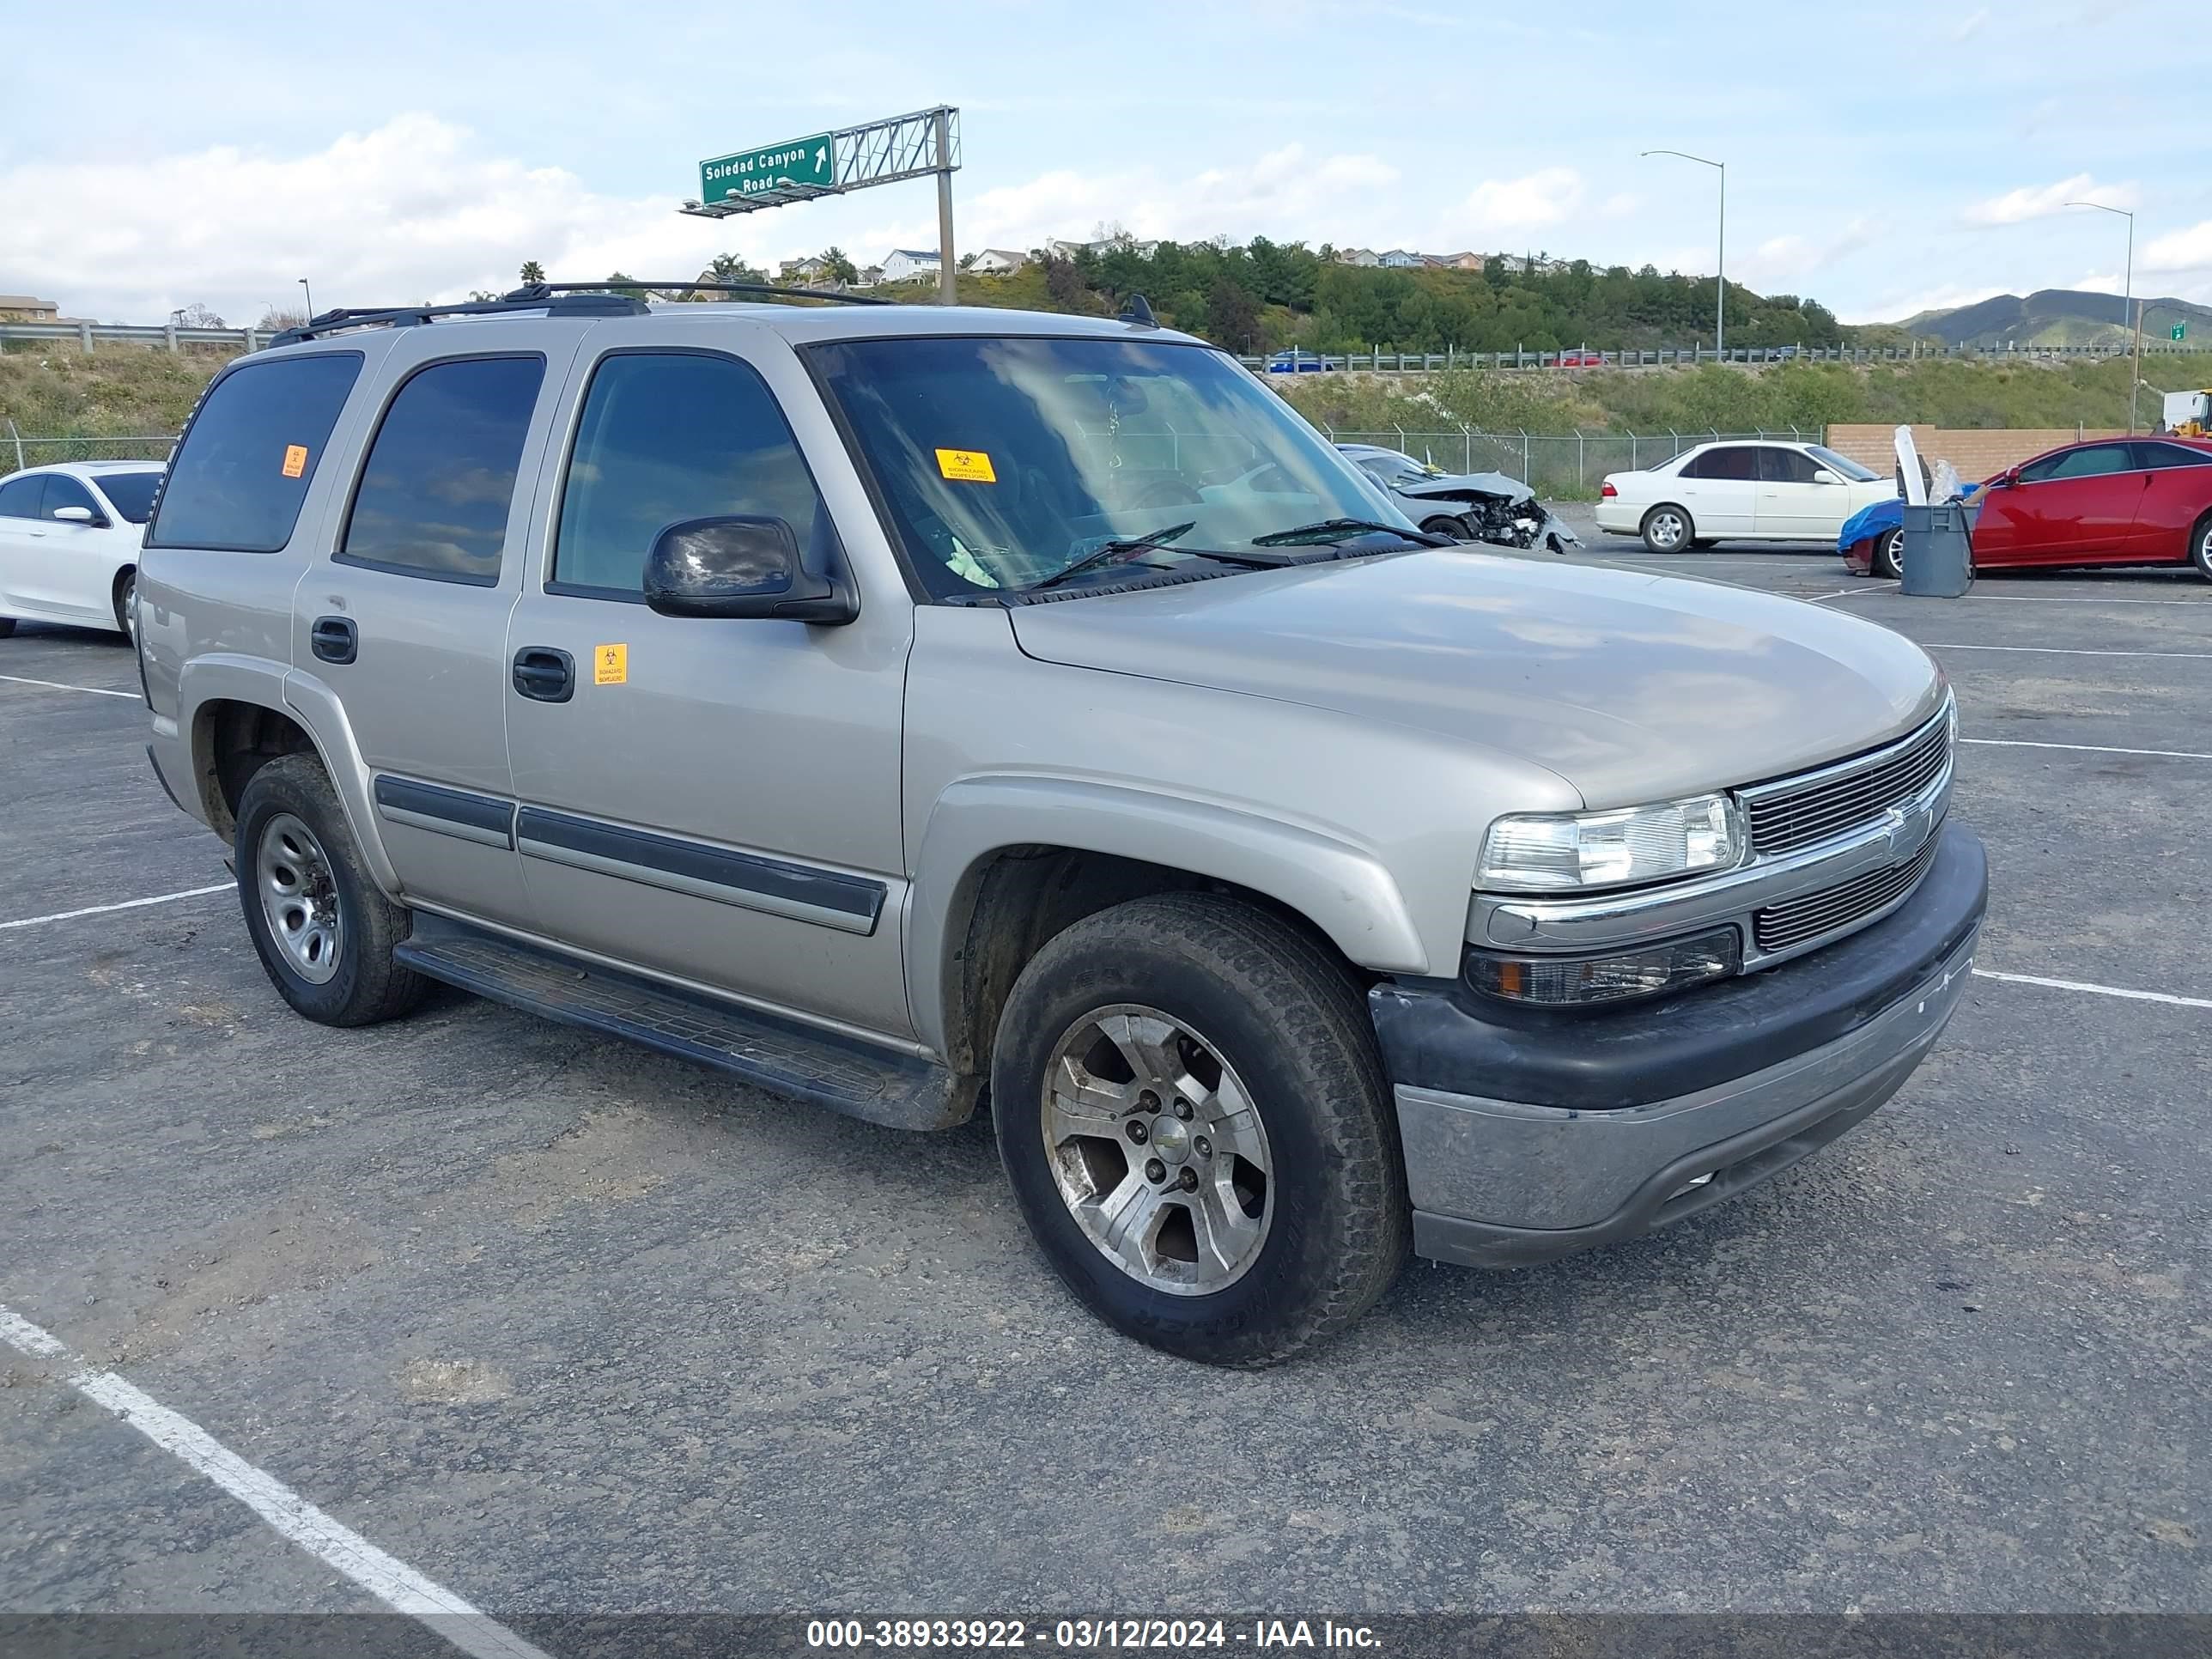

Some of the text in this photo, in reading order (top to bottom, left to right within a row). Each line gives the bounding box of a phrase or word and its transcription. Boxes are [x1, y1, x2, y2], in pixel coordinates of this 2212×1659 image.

[706, 149, 805, 180] Soledad Canyon
[743, 174, 773, 193] Road
